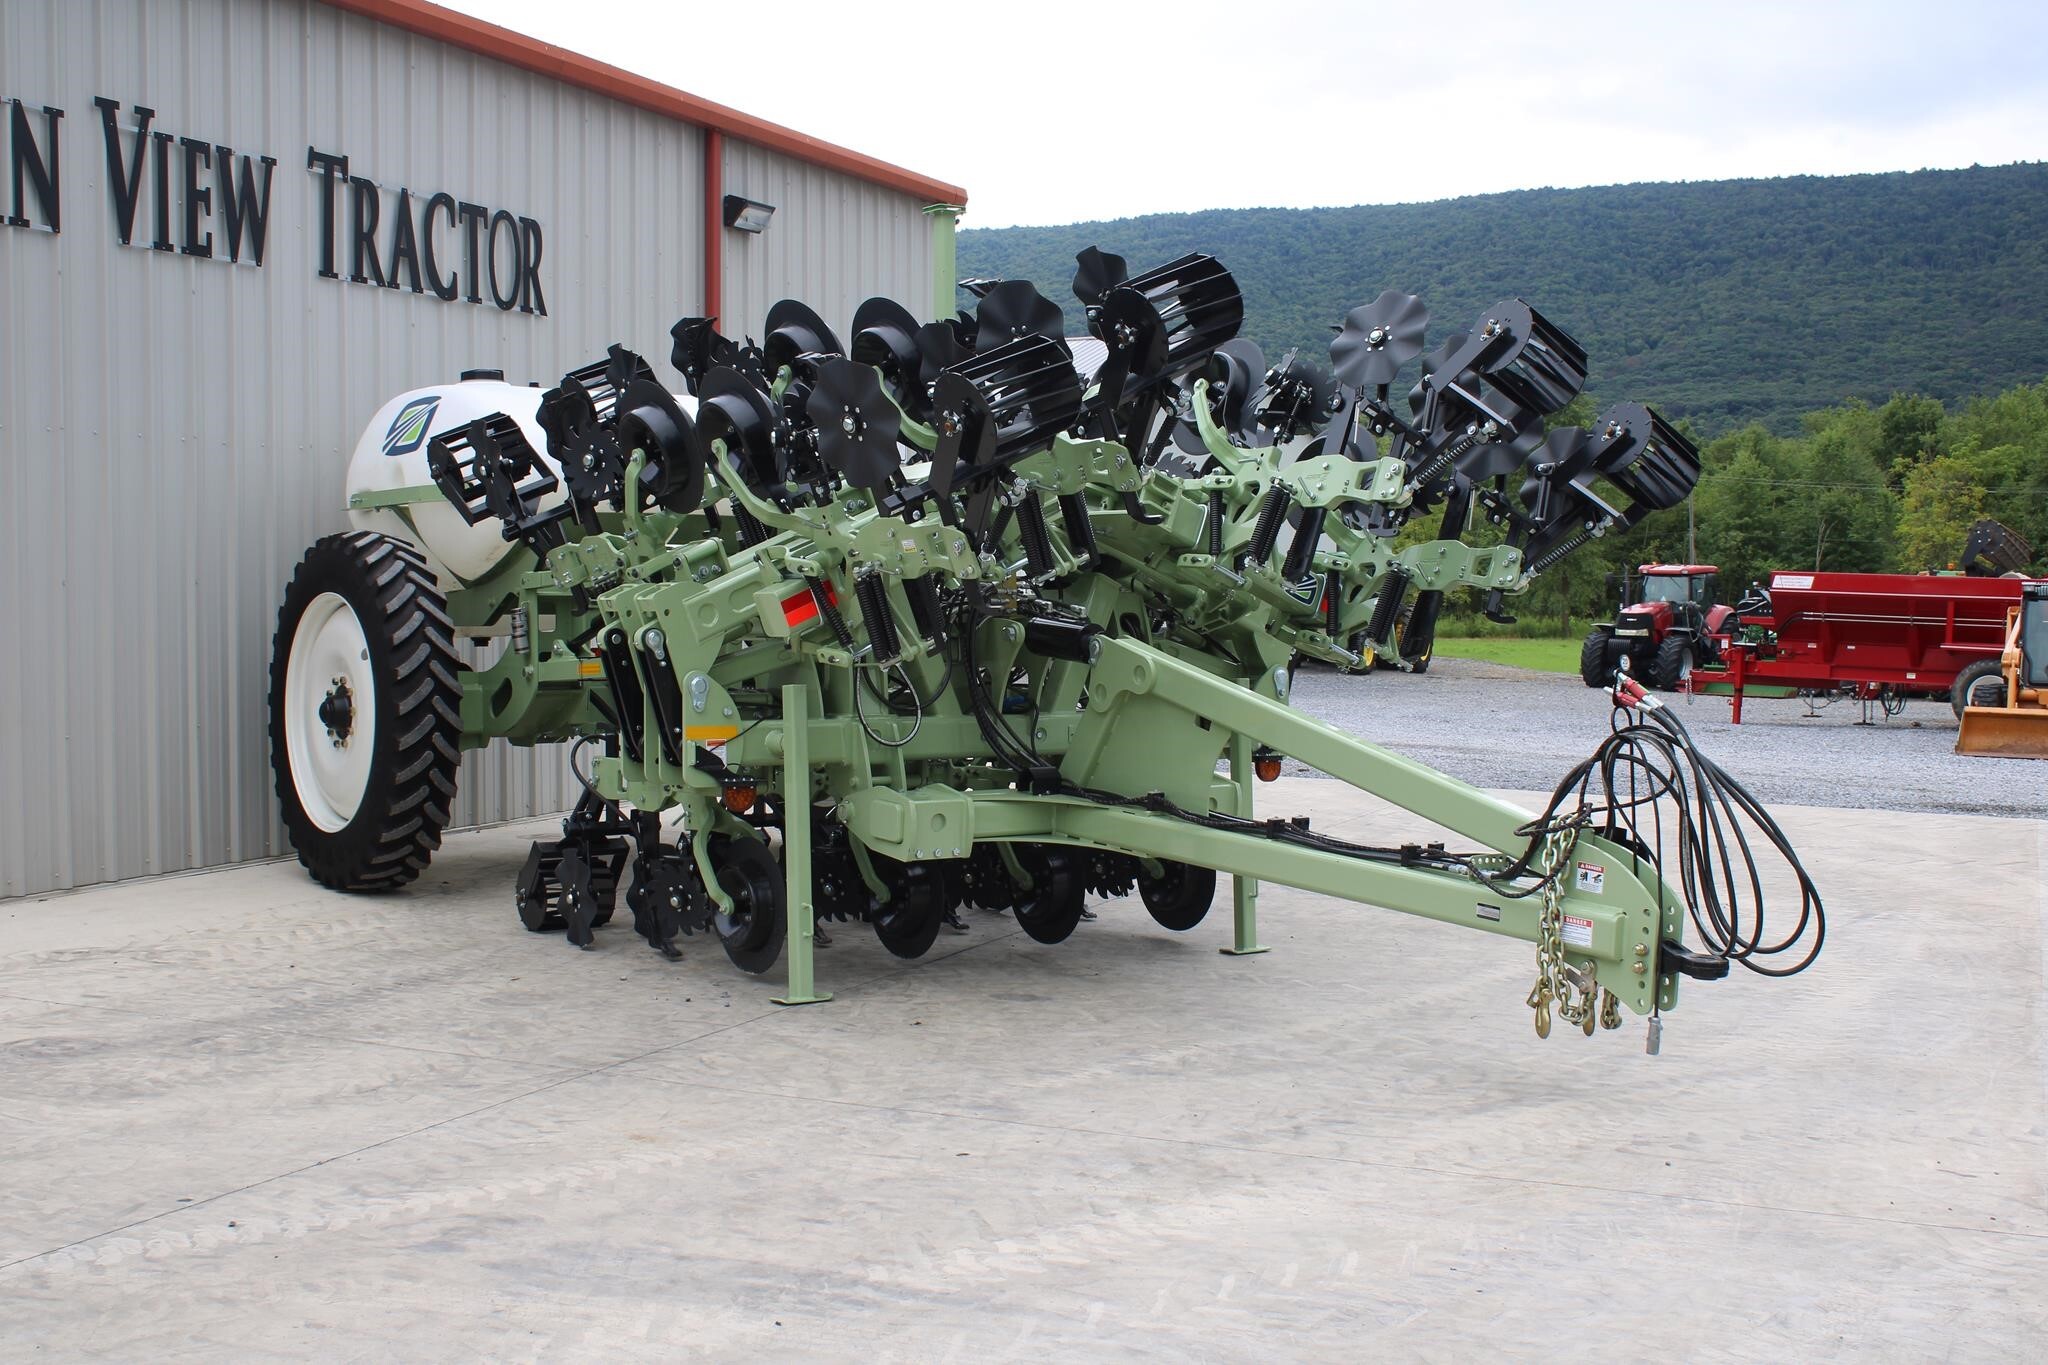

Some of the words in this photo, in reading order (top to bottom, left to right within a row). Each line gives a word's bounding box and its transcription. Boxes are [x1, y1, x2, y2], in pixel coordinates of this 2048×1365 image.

[0, 97, 65, 234] N
[94, 96, 278, 267] VIEW
[307, 145, 548, 317] TRACTOR
